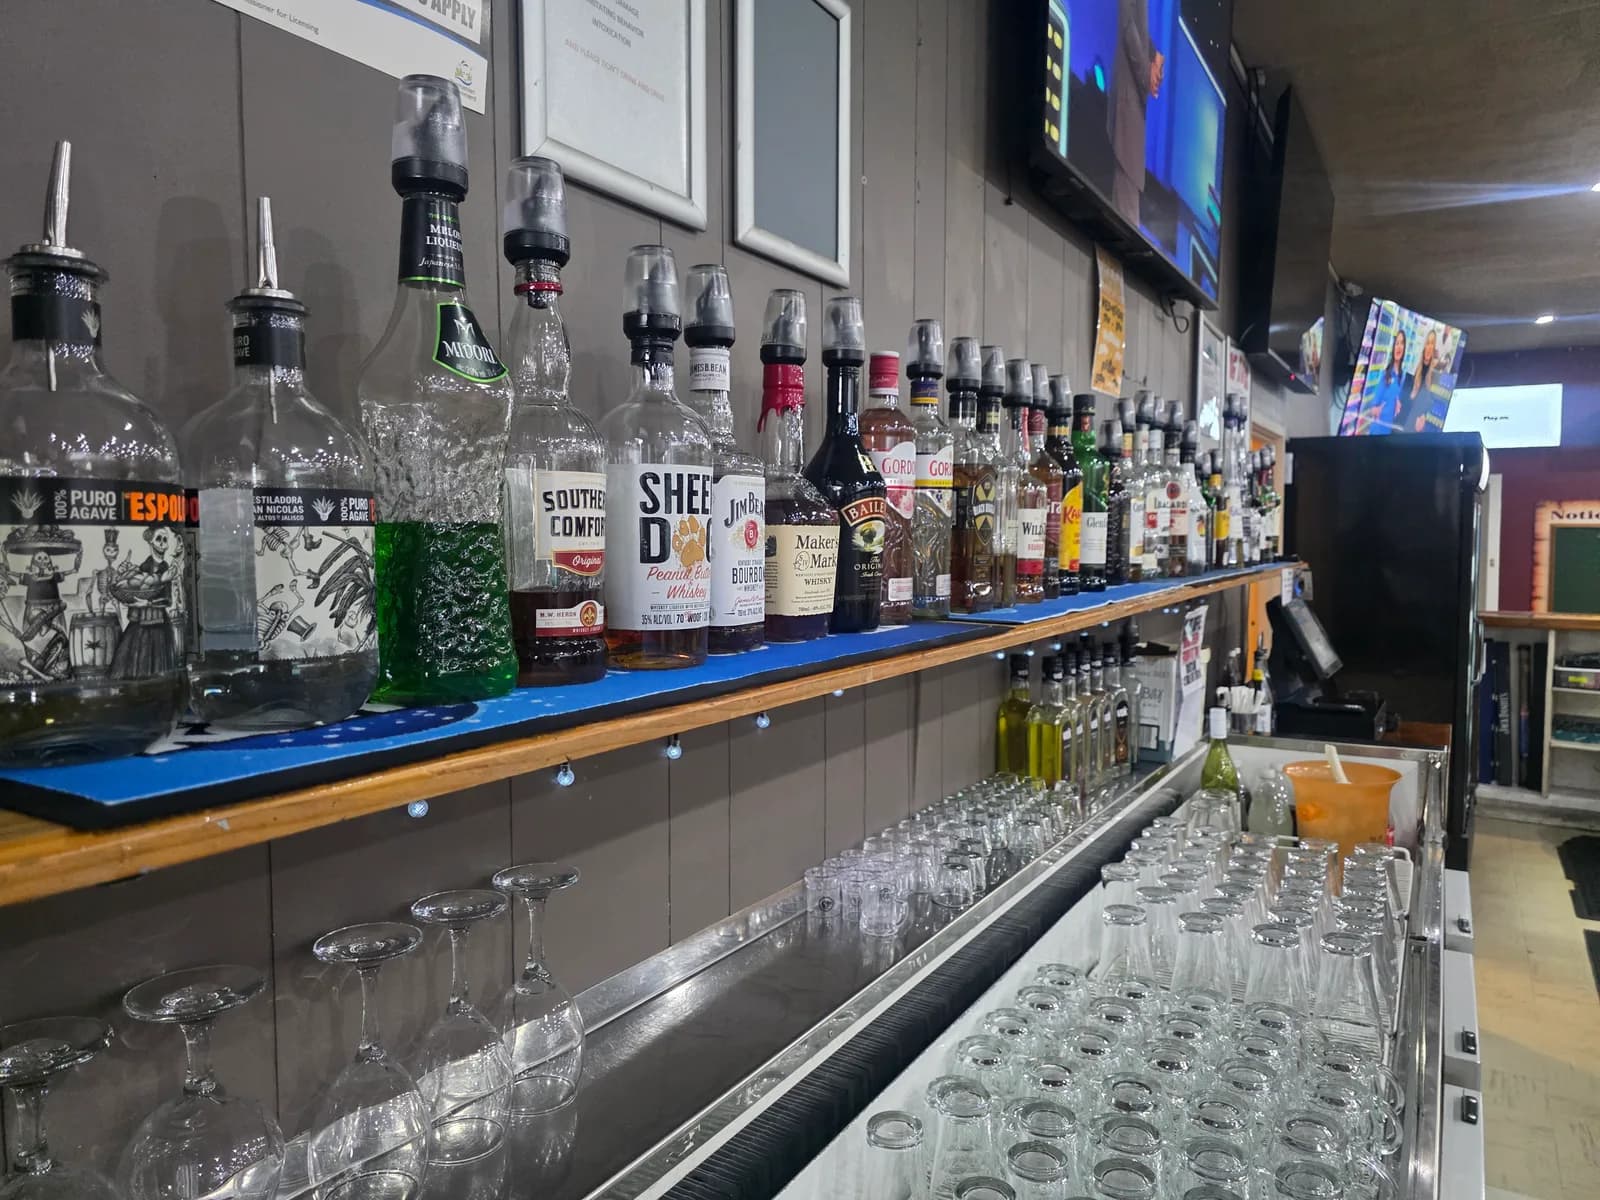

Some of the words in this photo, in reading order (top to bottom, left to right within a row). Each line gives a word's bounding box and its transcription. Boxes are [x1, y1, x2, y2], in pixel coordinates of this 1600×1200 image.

[426, 235, 463, 252] LIQUEU
[442, 340, 498, 365] MIDORI
[882, 457, 915, 474] GORD
[929, 459, 952, 476] GOR
[639, 471, 712, 515] SHEE
[54, 489, 67, 520] 100%
[70, 489, 117, 507] PURO
[266, 504, 305, 514] NICOLAS
[348, 497, 369, 510] PURO
[723, 497, 748, 529] JIM
[748, 491, 766, 521] BEA
[848, 501, 886, 520] BAILE
[69, 506, 117, 520] AGAVE
[348, 510, 369, 522] AGAVE
[795, 534, 839, 550] Maker's
[810, 552, 837, 569] Mark
[646, 566, 690, 581] Peanut
[732, 566, 765, 585] BOURBO
[804, 577, 832, 586] WHISKY
